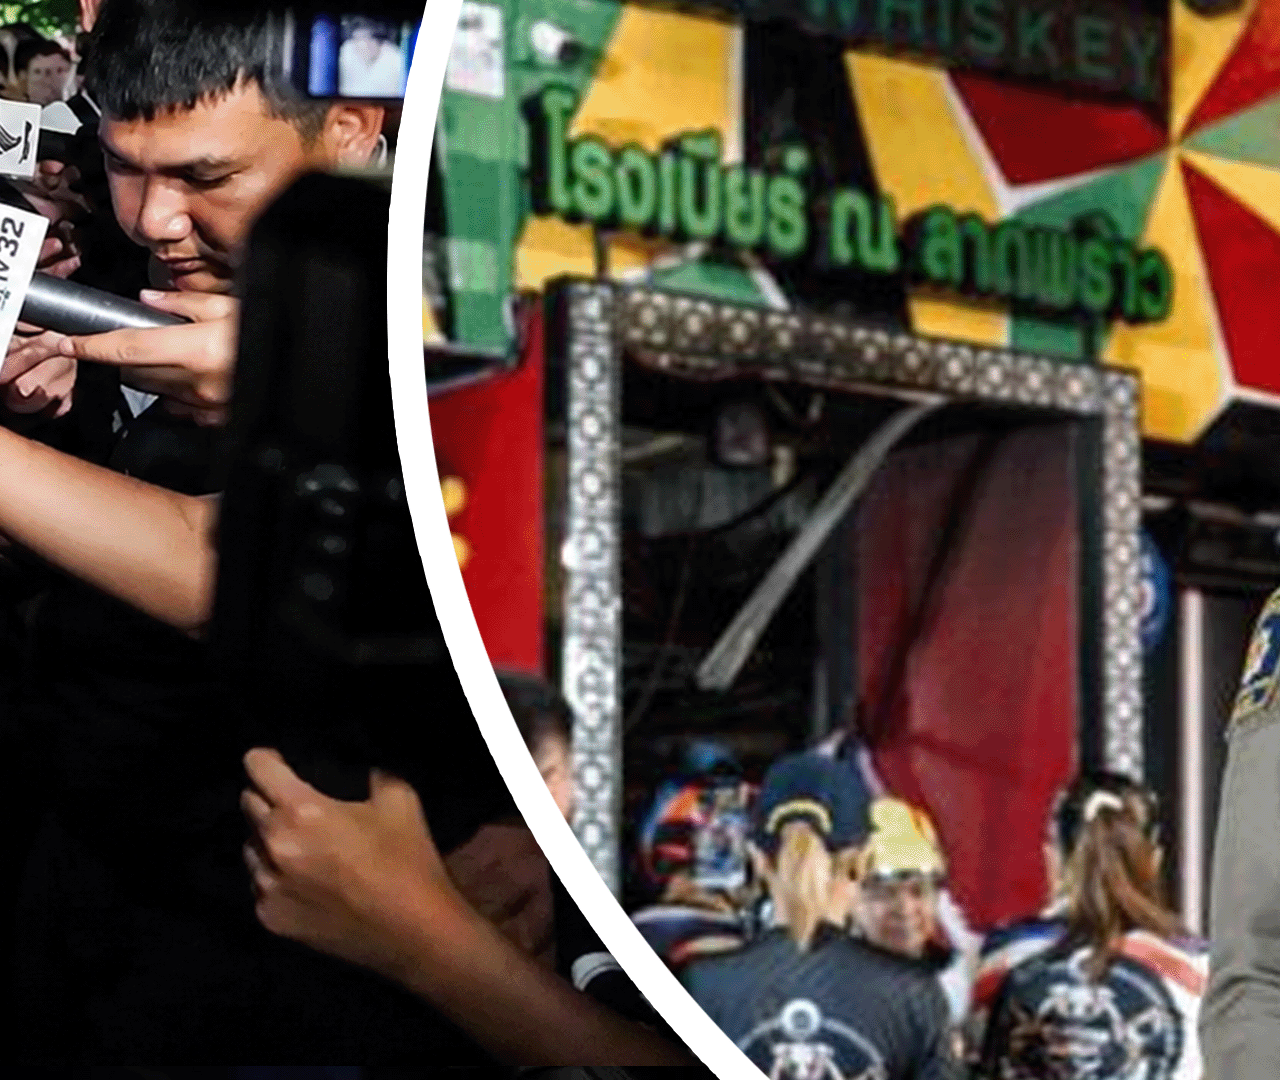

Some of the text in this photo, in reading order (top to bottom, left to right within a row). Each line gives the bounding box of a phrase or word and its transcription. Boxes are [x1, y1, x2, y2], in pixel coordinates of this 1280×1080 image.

[540, 85, 808, 258] โรงเบียร์
[831, 188, 899, 272] ณ
